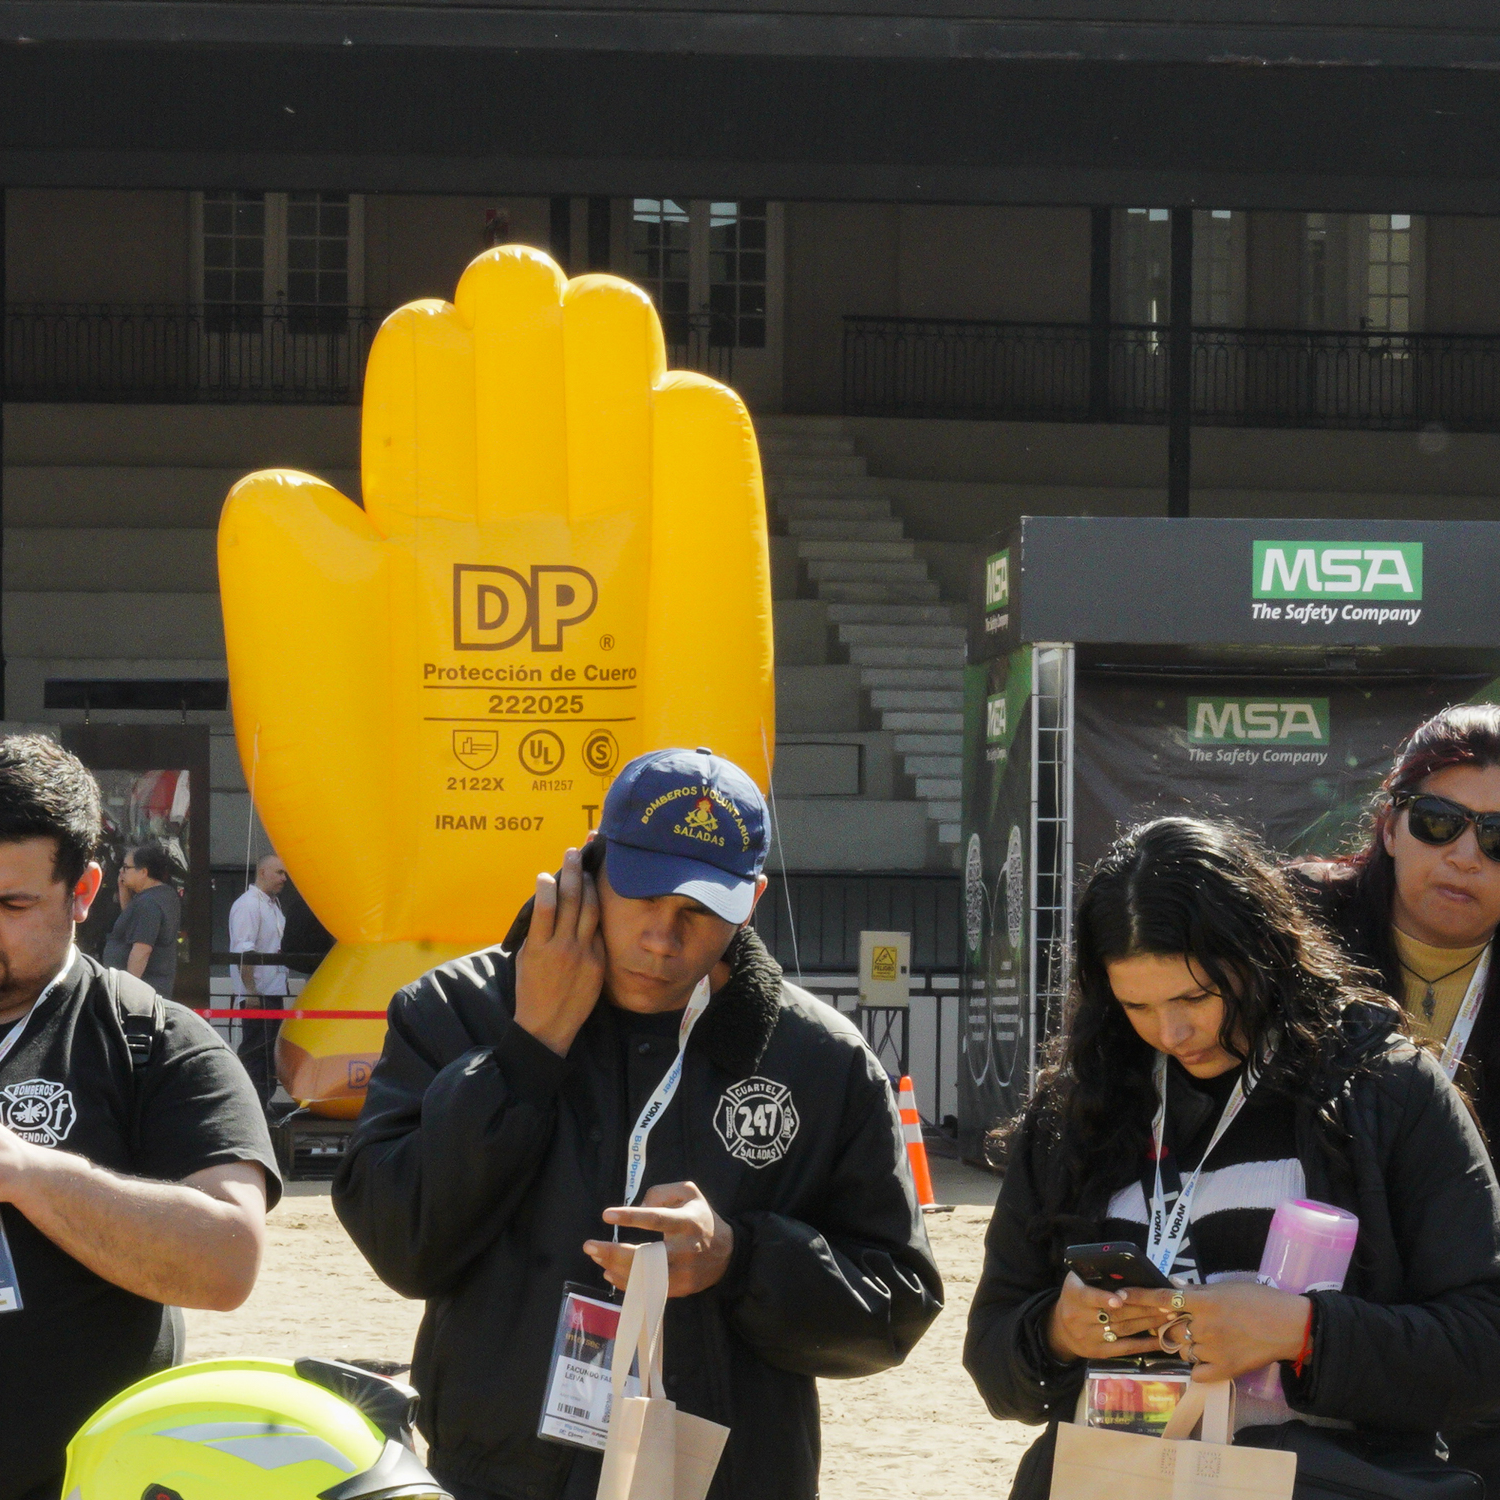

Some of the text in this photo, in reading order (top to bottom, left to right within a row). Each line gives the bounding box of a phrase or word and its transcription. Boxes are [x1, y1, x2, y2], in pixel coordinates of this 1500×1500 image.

[1261, 549, 1414, 593] MSA
[453, 563, 599, 652] DP
[1252, 603, 1421, 625] The Safety Company
[423, 662, 637, 682] Protección de Cuero
[488, 694, 584, 715] 222025
[1194, 702, 1322, 739] MSA
[1189, 748, 1328, 766] The Safety Company
[446, 777, 505, 792] 2122X
[531, 779, 574, 792] AR1257
[435, 814, 544, 832] IRAM 3607
[641, 786, 750, 853] BOMBEROS VOLUNTARIOS
[673, 824, 725, 847] SALADAS
[347, 1060, 378, 1089] D
[13, 1084, 55, 1097] BOMBEROS
[735, 1082, 777, 1097] CUARTEL
[640, 1101, 663, 1130] VORAN
[737, 1103, 778, 1137] 247
[16, 1132, 50, 1144] CENDIO
[629, 1134, 642, 1189] Big Dipper
[740, 1146, 777, 1160] SALADAS
[1153, 1209, 1162, 1246] VORAN
[1168, 1203, 1187, 1240] VORAN
[1158, 1248, 1172, 1276] pper
[564, 1371, 585, 1384] LEIVA
[566, 1363, 599, 1380] FACUNDO
